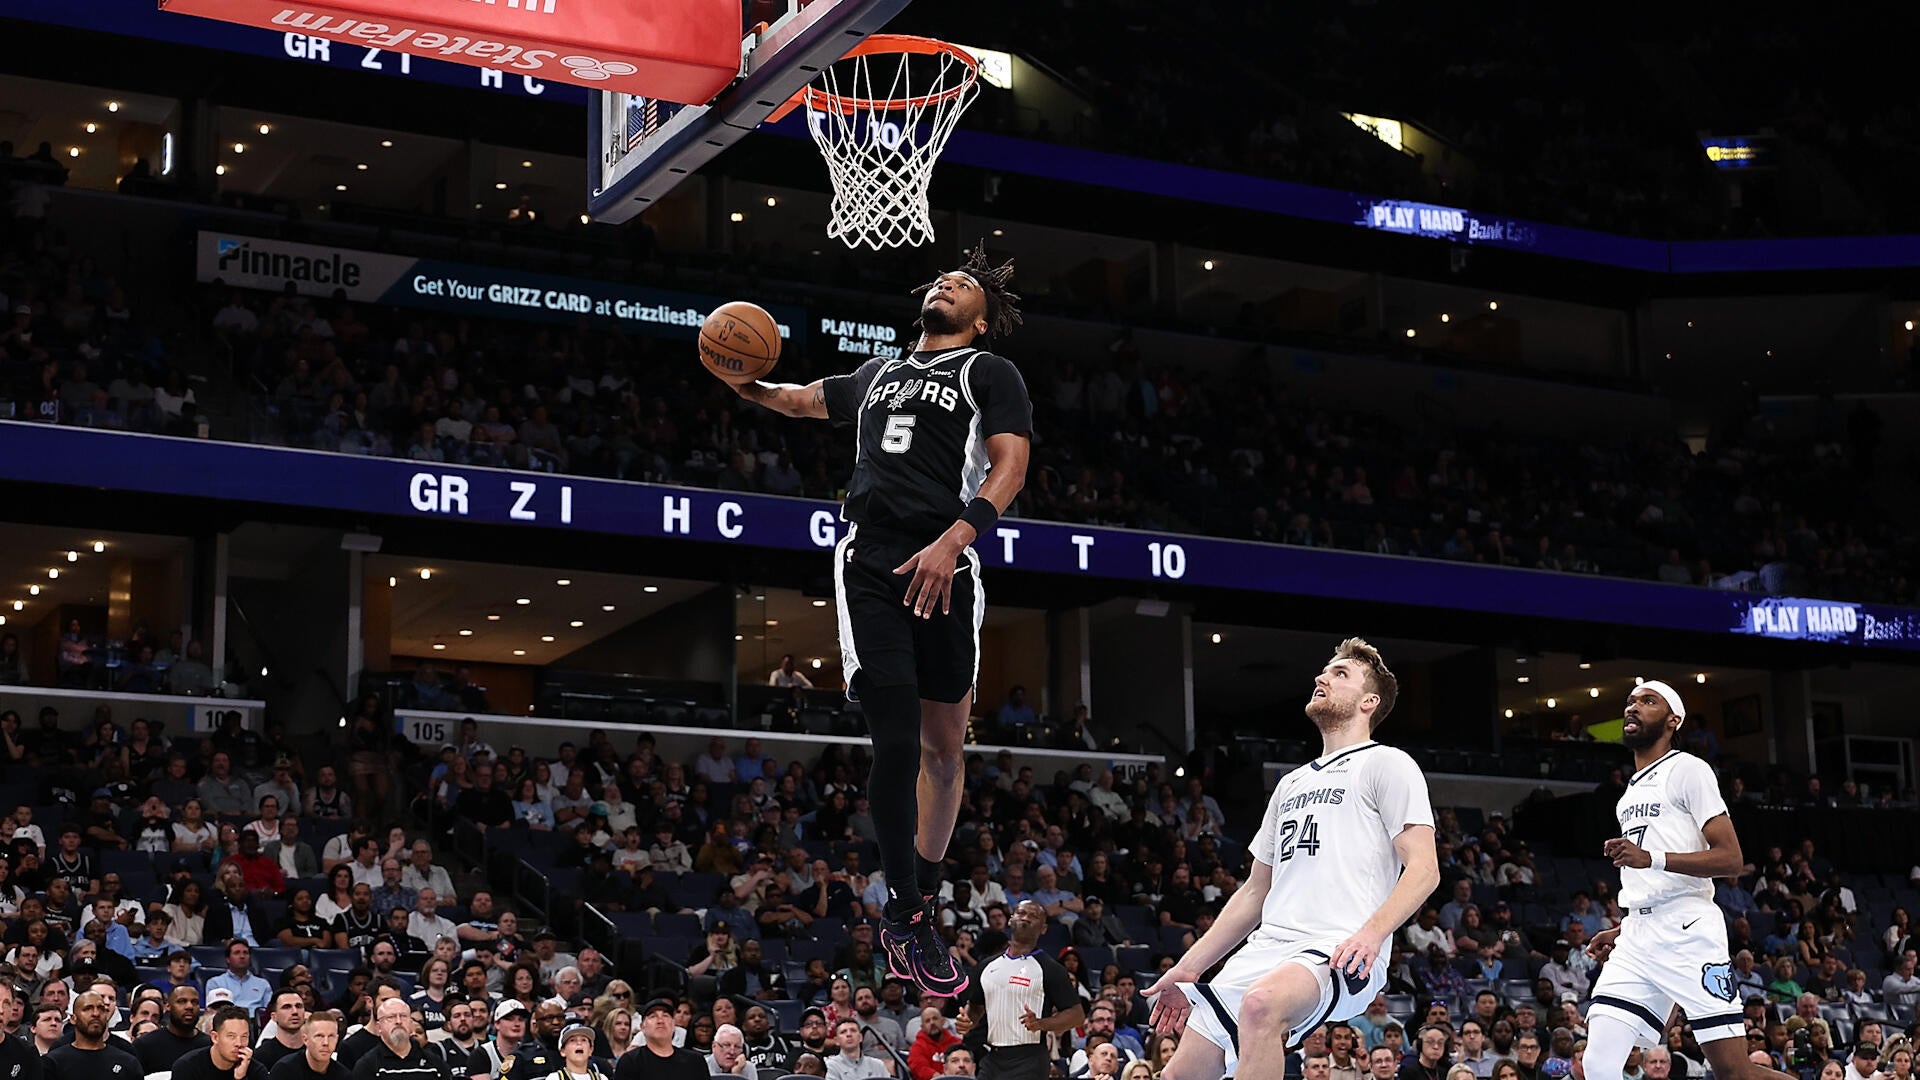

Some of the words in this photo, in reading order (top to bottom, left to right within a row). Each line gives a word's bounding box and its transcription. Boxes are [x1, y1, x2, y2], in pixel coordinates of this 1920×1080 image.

[1372, 206, 1415, 228] PLAY
[1419, 209, 1464, 232] HARD
[1469, 219, 1503, 240] Bank
[218, 239, 361, 287] Pinnacle
[414, 275, 444, 296] Get
[446, 279, 485, 301] Your
[488, 285, 541, 308] GRIZZ
[545, 290, 592, 314] CARD
[595, 300, 611, 317] at
[821, 319, 855, 337] PLAY
[857, 322, 896, 342] HARD
[838, 336, 871, 355] Bank
[873, 341, 902, 360] Easy
[881, 415, 917, 453] 5
[410, 472, 469, 514] GR
[509, 481, 536, 520] Z
[663, 495, 690, 534] H
[717, 501, 743, 538] C
[810, 510, 836, 547] G
[997, 528, 1020, 563] T
[1071, 535, 1094, 570] T
[1148, 542, 1186, 579] 10
[1752, 606, 1799, 633] PLAY
[1806, 606, 1857, 633] HARD
[206, 710, 224, 728] 10
[412, 722, 445, 742] 105
[1621, 803, 1661, 826] MPHIS
[1280, 814, 1320, 863] 24
